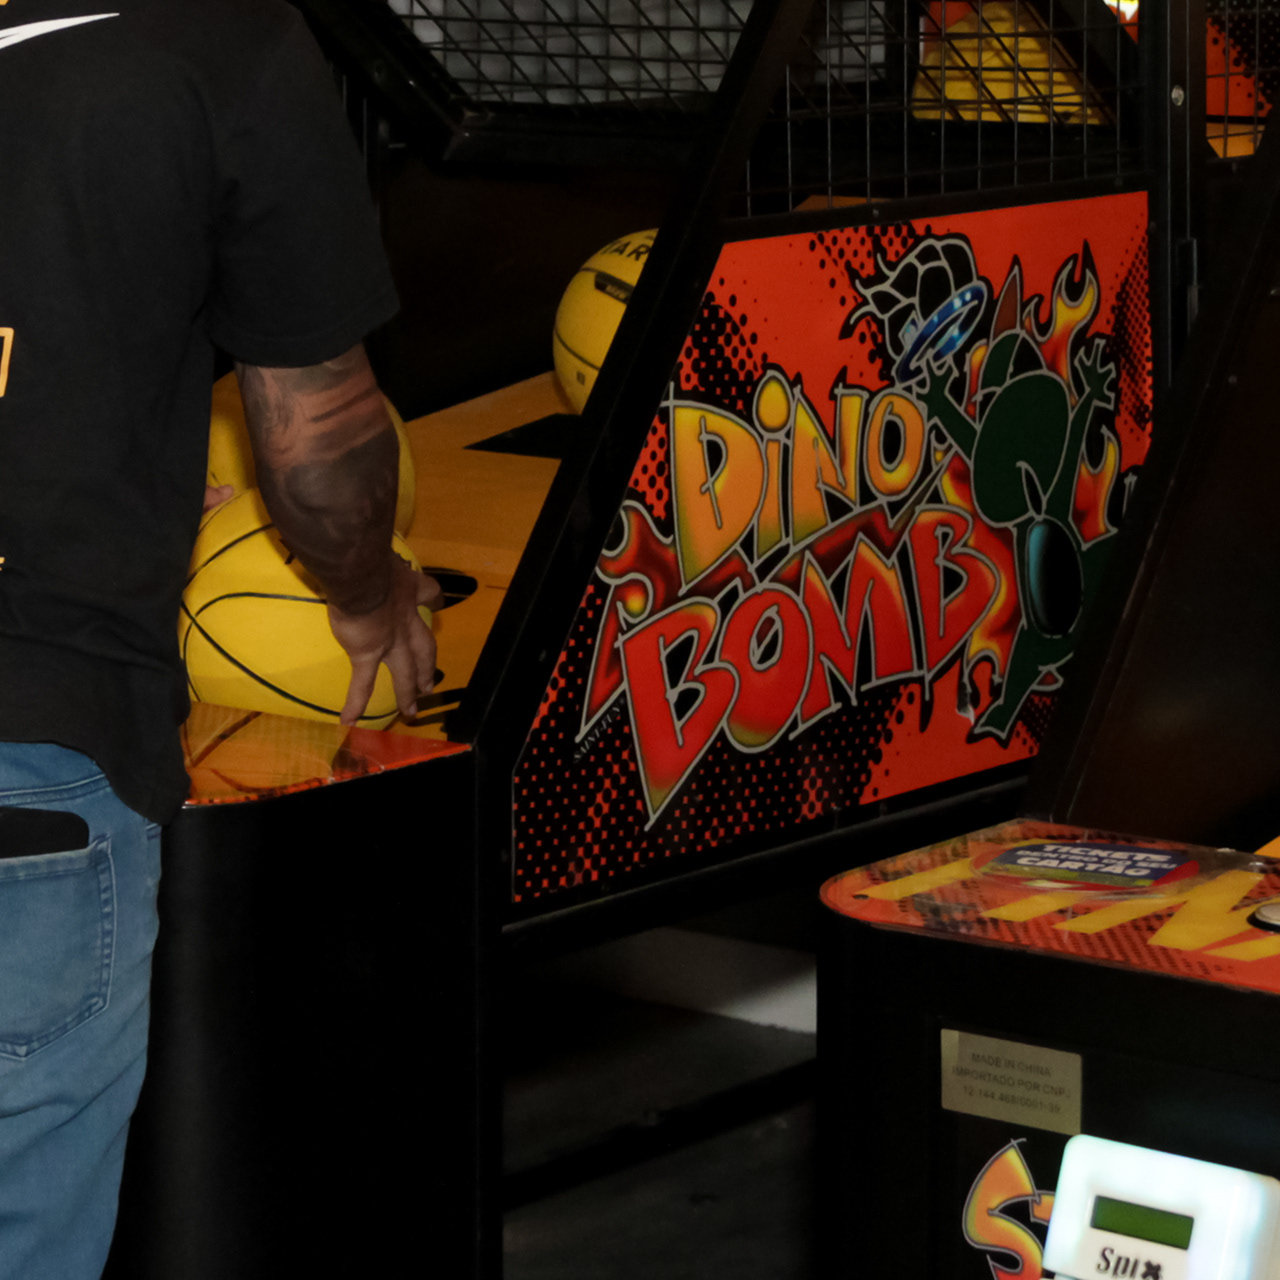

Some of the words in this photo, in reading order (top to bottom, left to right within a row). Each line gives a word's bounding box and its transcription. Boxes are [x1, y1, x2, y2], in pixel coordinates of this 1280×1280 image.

[619, 504, 1003, 830] BOMB
[1015, 850, 1098, 862] DENTRO
[1135, 861, 1177, 869] SEU
[1043, 844, 1171, 862] TICKETS
[1017, 856, 1151, 876] CARTÃO
[972, 1053, 1001, 1068] MADE
[1004, 1060, 1015, 1069] IN
[1017, 1061, 1052, 1077] CHINA
[952, 1065, 1016, 1087] IMPORTADO
[1018, 1080, 1040, 1093] POR
